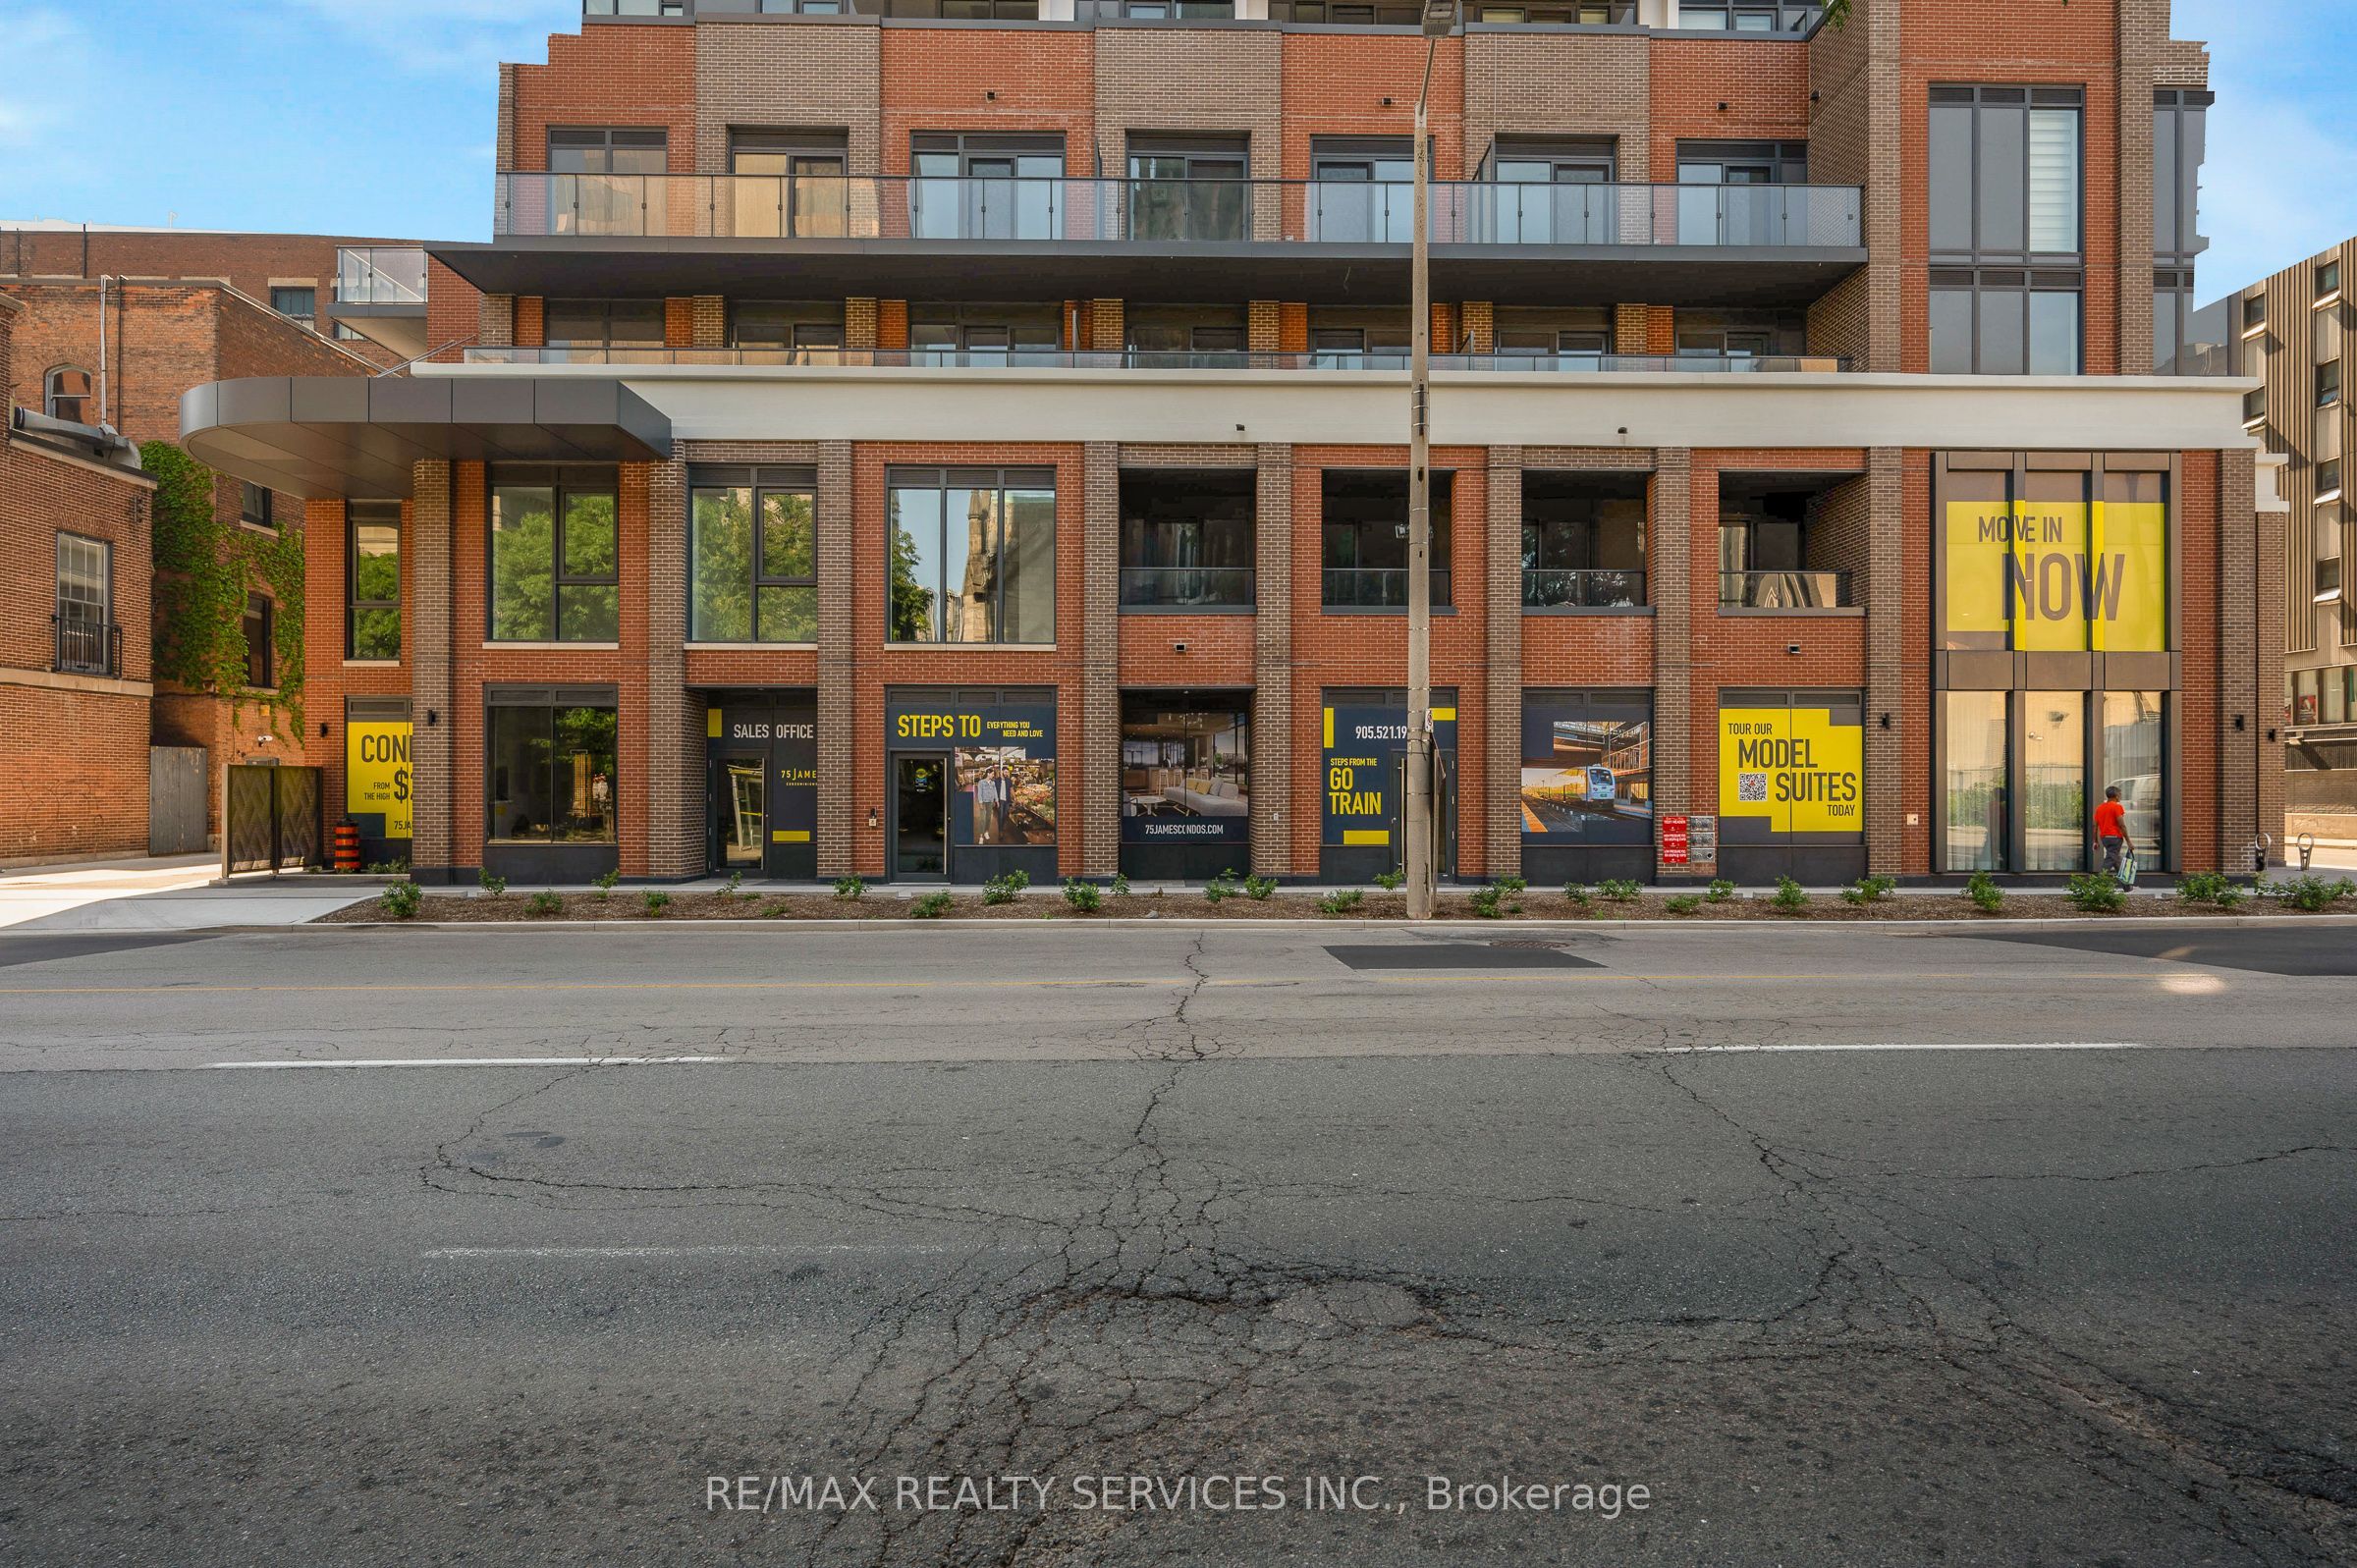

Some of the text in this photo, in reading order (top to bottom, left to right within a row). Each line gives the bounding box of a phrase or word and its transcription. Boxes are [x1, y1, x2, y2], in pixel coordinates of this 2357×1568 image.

[1978, 515, 2062, 542] MOVE IN
[2001, 552, 2125, 621] NOW
[733, 724, 814, 738] SALES OFFICE
[898, 714, 981, 737] STEPS TO
[986, 721, 1030, 730] EVERYTHING YOU
[1727, 723, 1773, 734] TOUR OUR
[360, 734, 412, 763] CON
[1738, 738, 1819, 769] MODEL
[373, 782, 391, 790] FROM
[1330, 767, 1354, 790] GO
[1775, 772, 1857, 802] SUITES
[1329, 791, 1382, 815] TRAIN
[1827, 804, 1856, 817] TODAY
[1145, 825, 1224, 835] 75JAMESCONDOS.COM
